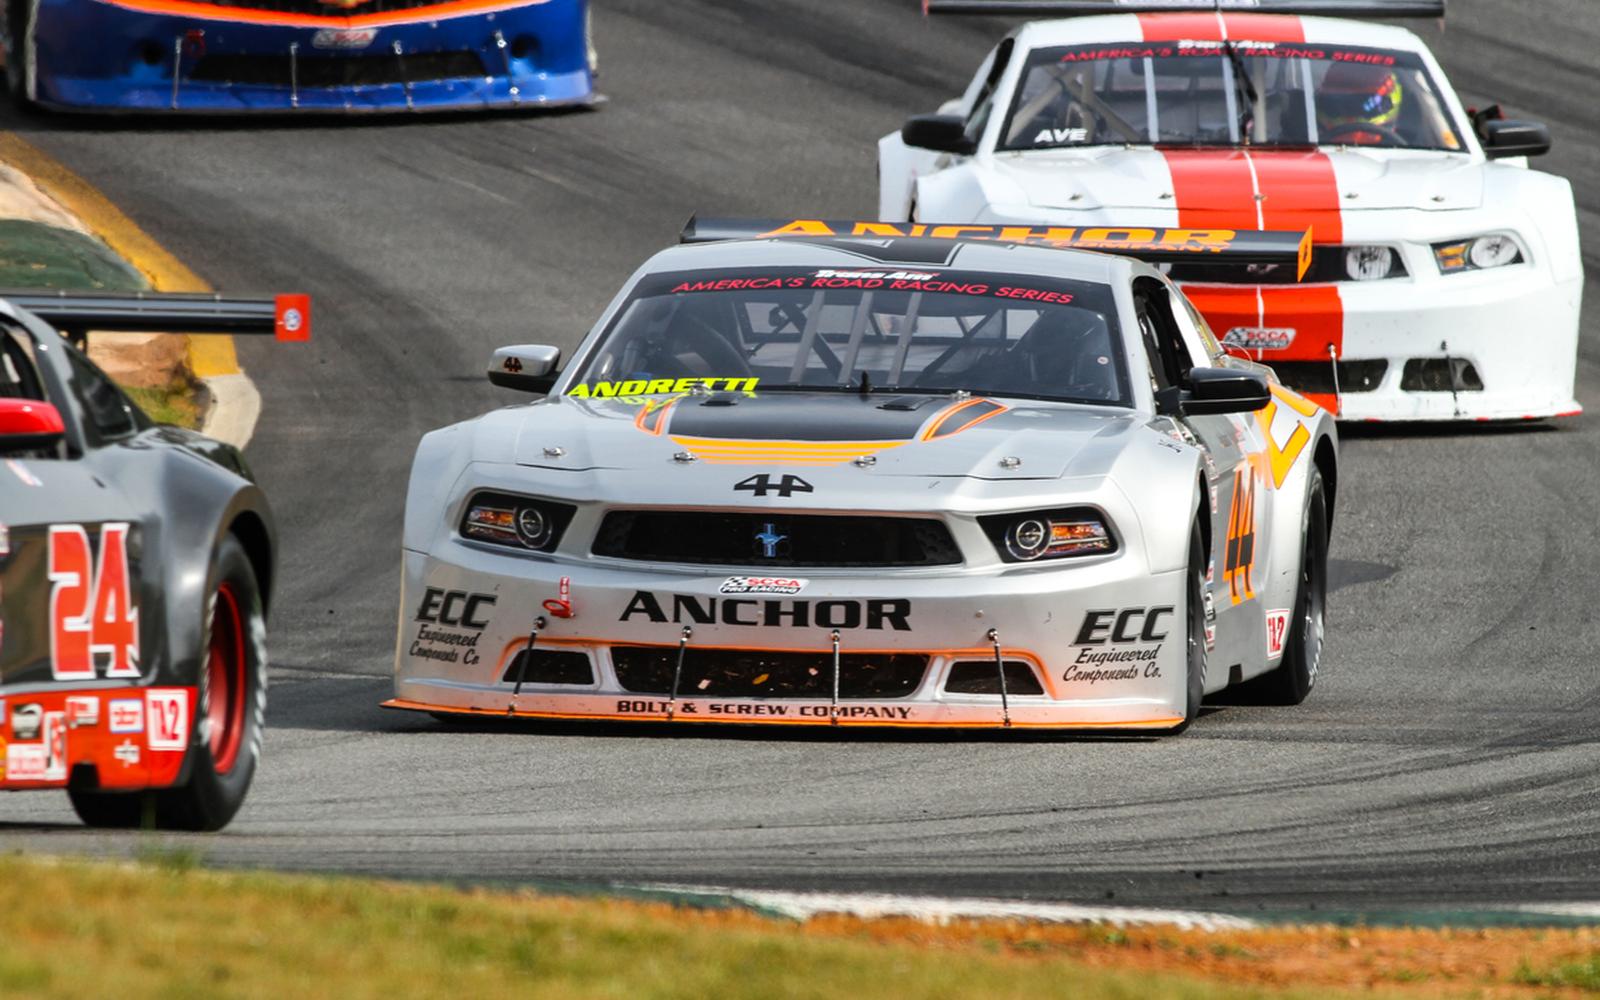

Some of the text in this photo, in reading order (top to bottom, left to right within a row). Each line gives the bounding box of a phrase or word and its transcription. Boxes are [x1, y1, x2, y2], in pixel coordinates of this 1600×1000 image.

[1244, 47, 1325, 60] RACING
[1331, 51, 1396, 65] SERIES
[1034, 127, 1088, 143] AVE
[755, 219, 1237, 246] ANCHOR
[815, 269, 933, 281] Trans Am
[671, 276, 1074, 304] AMERICA'S ROAD RACING SERIES
[567, 377, 760, 398] ANDRETTI
[733, 473, 814, 498] 44
[721, 585, 800, 594] PRO RACING
[746, 577, 800, 587] SCCA
[48, 522, 142, 681] 24
[414, 586, 498, 631] ECC
[618, 590, 913, 631] ANCHOR
[418, 624, 482, 648] Engineered
[1068, 605, 1175, 647] ECC
[409, 641, 459, 663] Components
[1075, 644, 1162, 667] Engineered
[1063, 661, 1162, 684] Components Co.
[617, 700, 911, 719] BOLT & SCREW COMPANY
